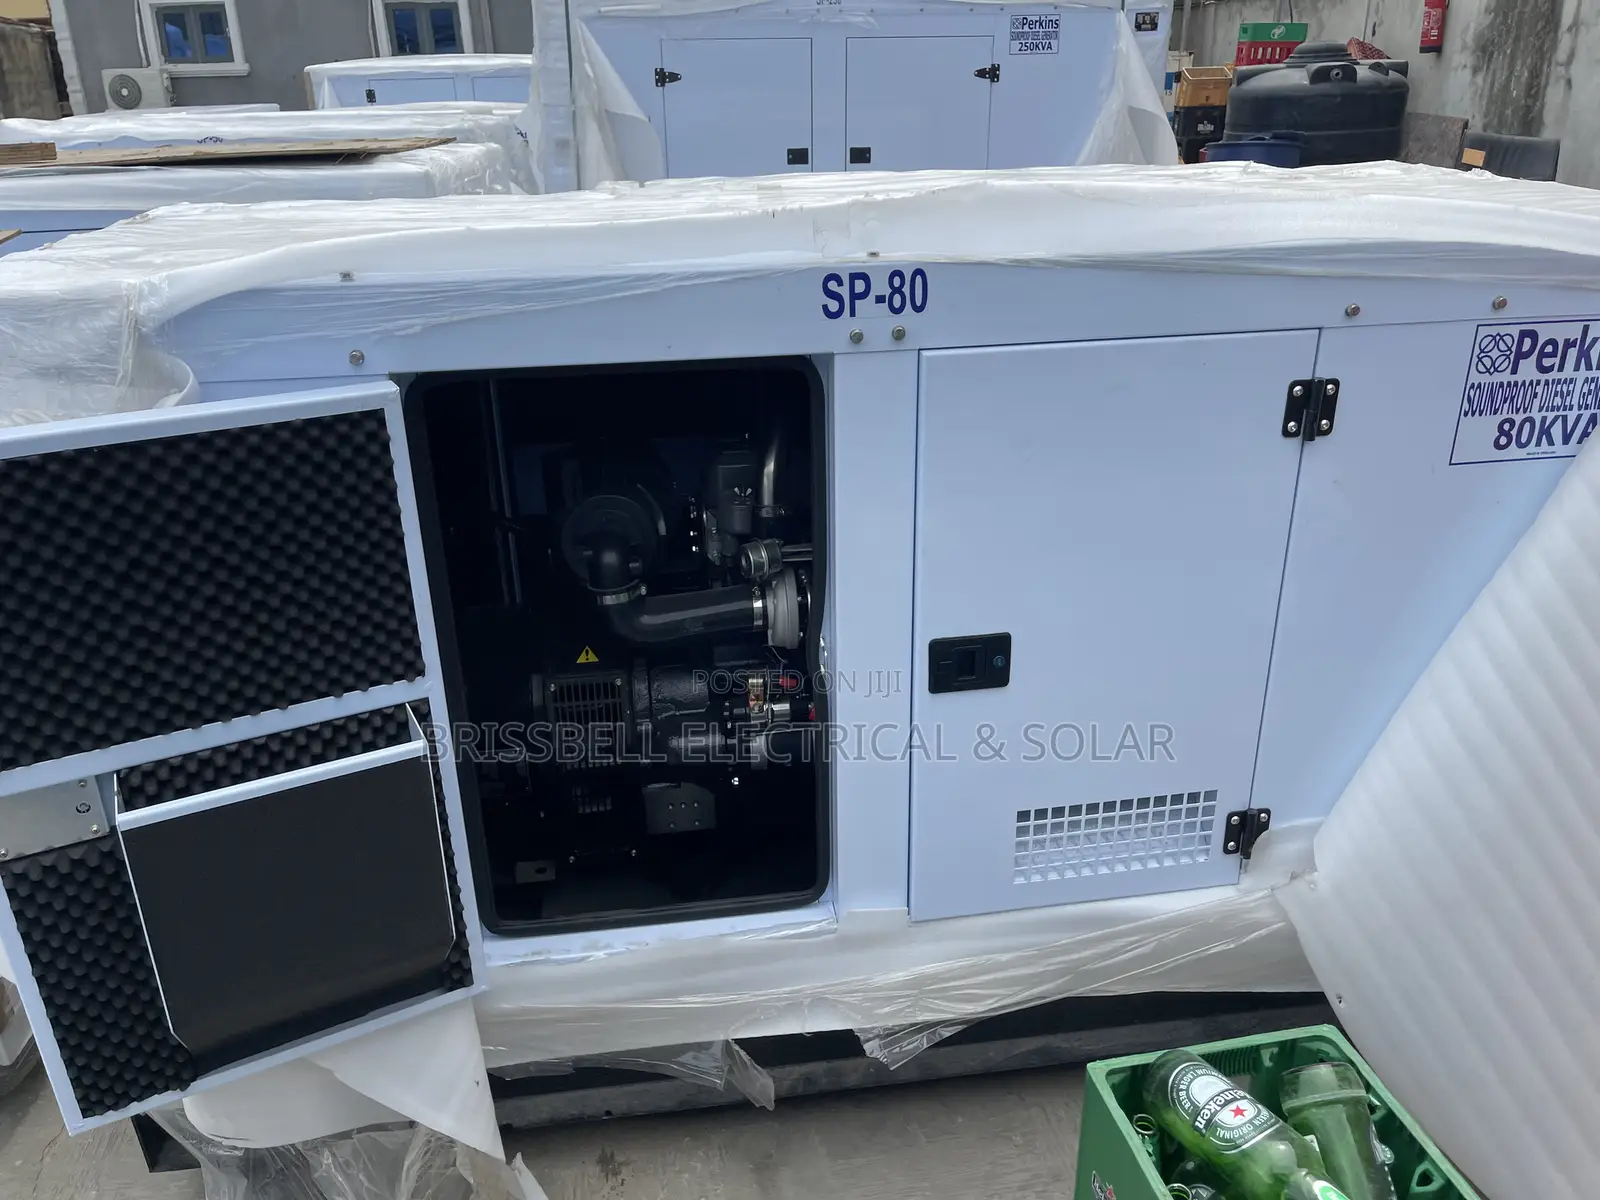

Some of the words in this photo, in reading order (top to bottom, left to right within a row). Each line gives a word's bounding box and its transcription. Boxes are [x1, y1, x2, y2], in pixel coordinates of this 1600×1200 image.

[1021, 15, 1059, 30] Perkins
[1018, 41, 1053, 52] 250KVA
[821, 267, 929, 320] SP-80
[1510, 324, 1600, 375] Perk
[1463, 378, 1542, 418] SOUNDPROOF
[1537, 377, 1578, 413] DIESEL
[1179, 1071, 1197, 1090] LAGER
[1216, 1123, 1254, 1140] ORIGINAL
